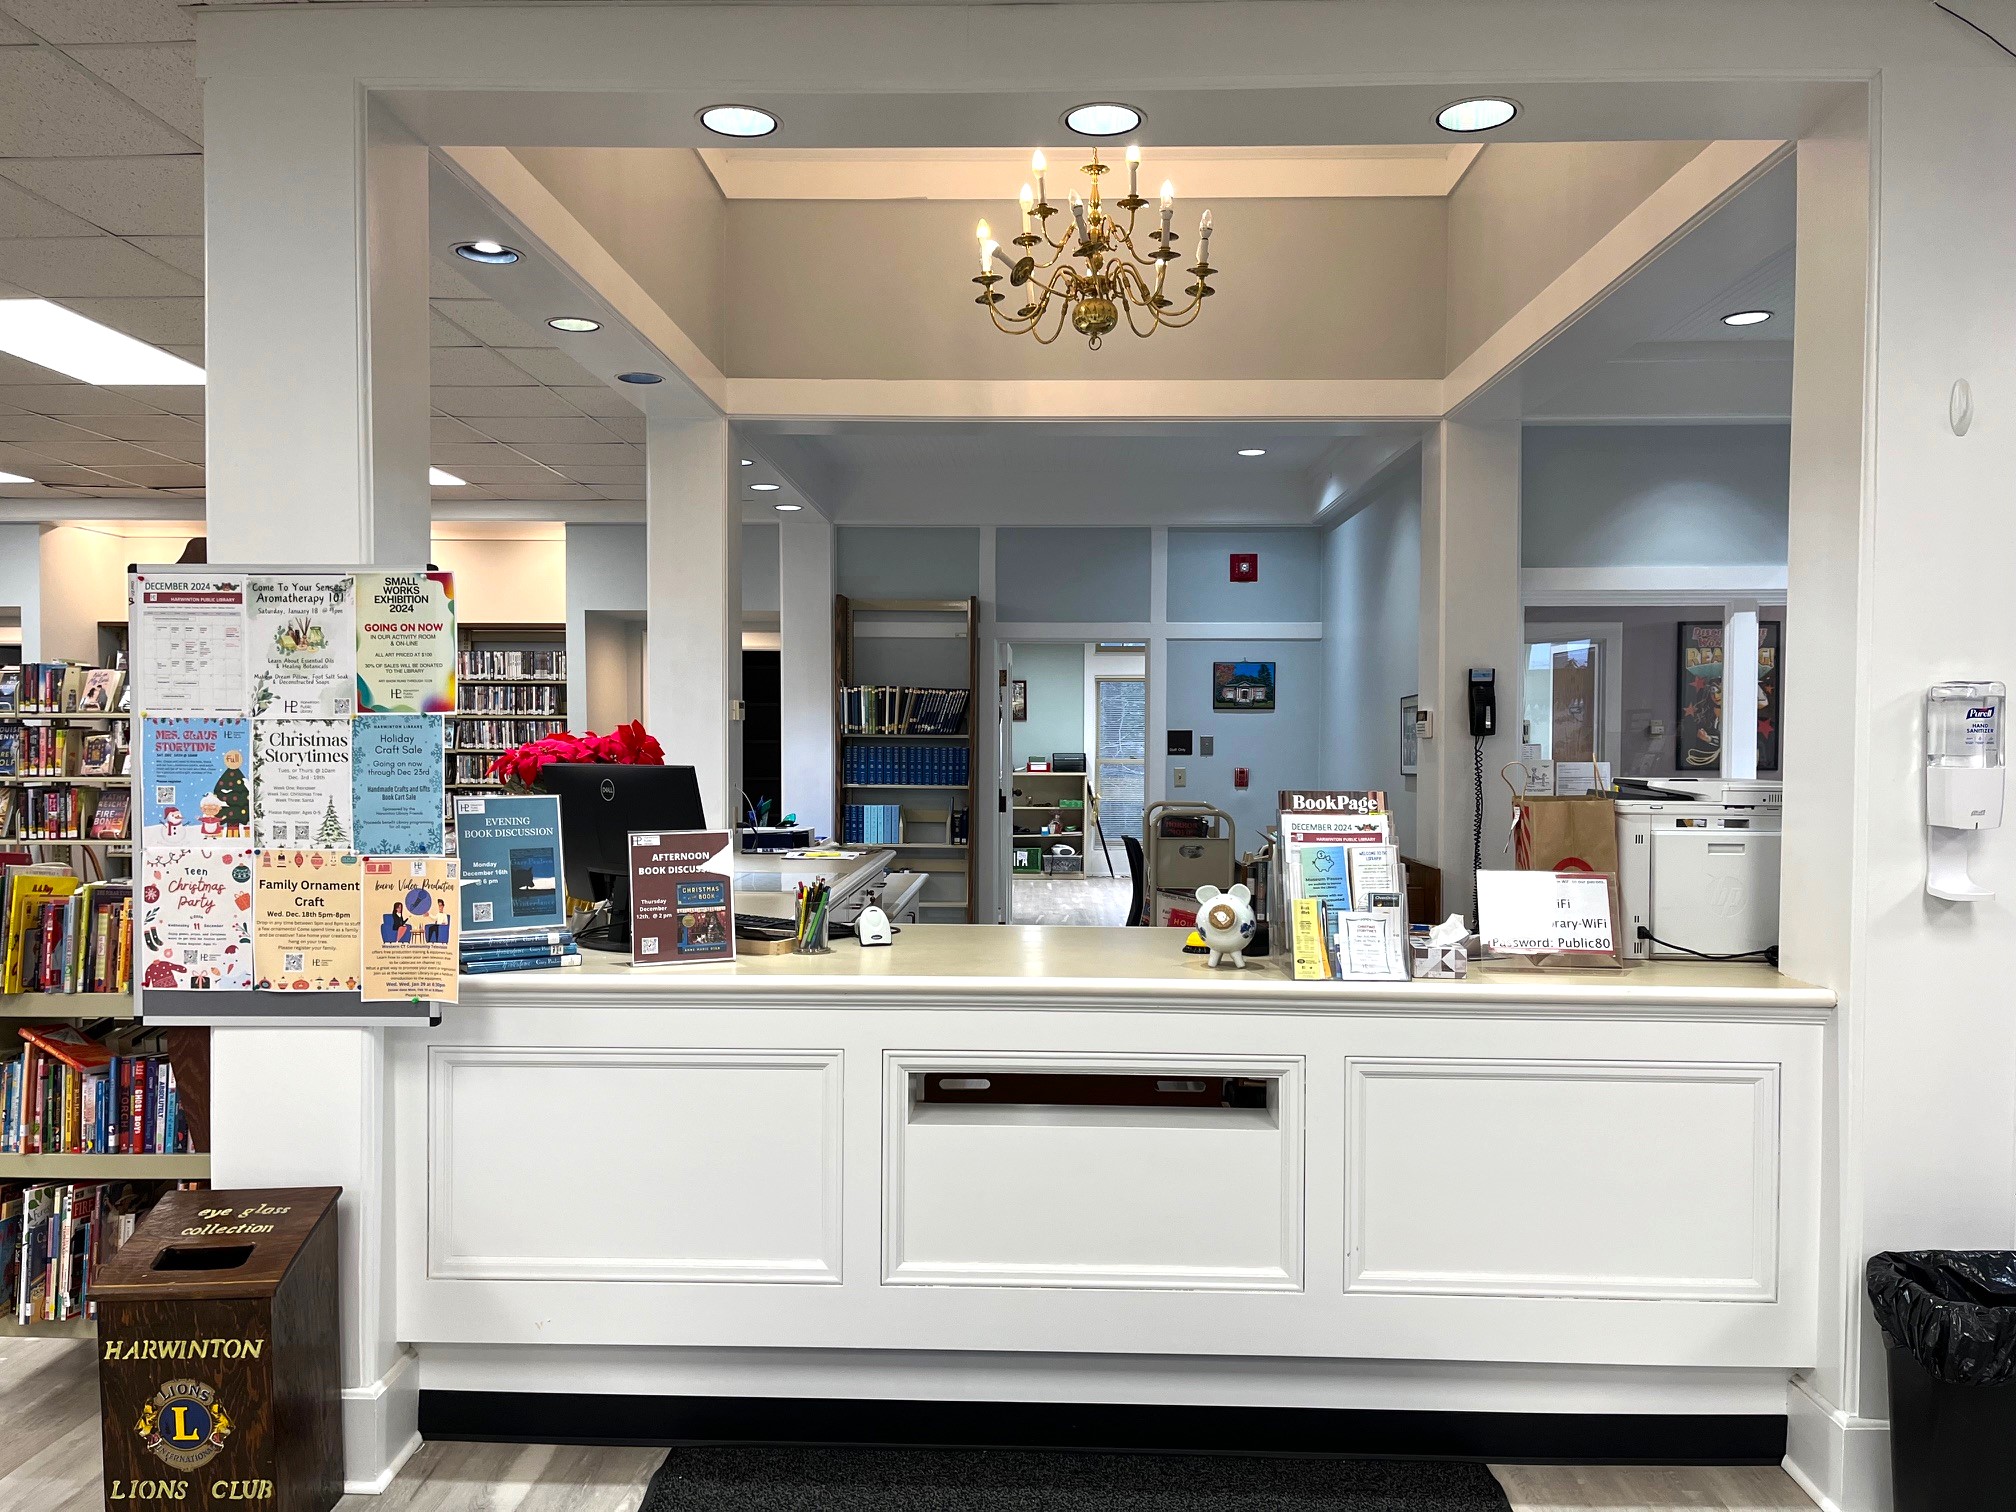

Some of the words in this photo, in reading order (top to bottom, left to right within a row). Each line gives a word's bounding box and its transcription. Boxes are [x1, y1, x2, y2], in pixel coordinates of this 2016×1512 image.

[145, 582, 189, 591] DECEMBER
[191, 582, 211, 591] 2024
[252, 583, 274, 592] Come
[278, 583, 288, 592] To
[292, 582, 312, 592] Your
[385, 577, 418, 586] SMALL
[383, 586, 420, 595] WORKS
[256, 593, 324, 605] Aromatherapy
[329, 593, 344, 603] 101
[374, 595, 429, 604] EXHIBITION
[389, 604, 414, 613] 2024
[364, 623, 397, 632] GOING
[400, 623, 416, 632] ON
[417, 623, 443, 632] NOW
[155, 730, 180, 740] MRS.
[183, 730, 218, 740] CLAUS
[269, 732, 348, 747] Christmas
[380, 734, 415, 745] Holiday
[155, 742, 216, 752] STORYTIME
[374, 745, 399, 754] Craft
[402, 745, 422, 754] Sale
[265, 748, 349, 767] Storytimes
[372, 760, 395, 769] Going
[368, 768, 395, 778] through
[397, 768, 411, 776] Dec
[413, 768, 430, 776] 23rd
[394, 793, 405, 801] Cart
[1292, 794, 1378, 814] BookPage
[95, 810, 115, 818] FIRE
[485, 817, 530, 827] EVENING
[1291, 823, 1332, 831] DECEMBER
[1334, 823, 1352, 831] 2024
[464, 829, 493, 839] BOOK
[495, 827, 554, 838] DISCUSSION
[651, 851, 710, 862] AFTERNOON
[184, 867, 208, 876] Teen
[638, 867, 667, 876] BOOK
[668, 865, 710, 874] DISCUS
[168, 877, 226, 895] Christmas
[259, 879, 298, 892] Family
[300, 880, 360, 891] Ornament
[398, 879, 418, 891] Video
[682, 886, 720, 894] CHRISTMAS
[294, 896, 325, 907] Craft
[1556, 899, 1571, 909] iFi
[318, 911, 351, 919] 5pm-8pm
[1551, 918, 1607, 930] rary-WiFi
[1492, 938, 1554, 948] Psword:
[1558, 937, 1611, 949] Public80
[134, 1089, 143, 1114] GHOST
[197, 1208, 233, 1220] eye
[237, 1203, 292, 1219] glass
[181, 1223, 275, 1236] collection
[103, 1338, 265, 1360] HARWINTON
[157, 1383, 210, 1401] LIONS
[171, 1406, 200, 1441] L
[109, 1479, 189, 1500] LIONS
[211, 1479, 275, 1500] CLUB
